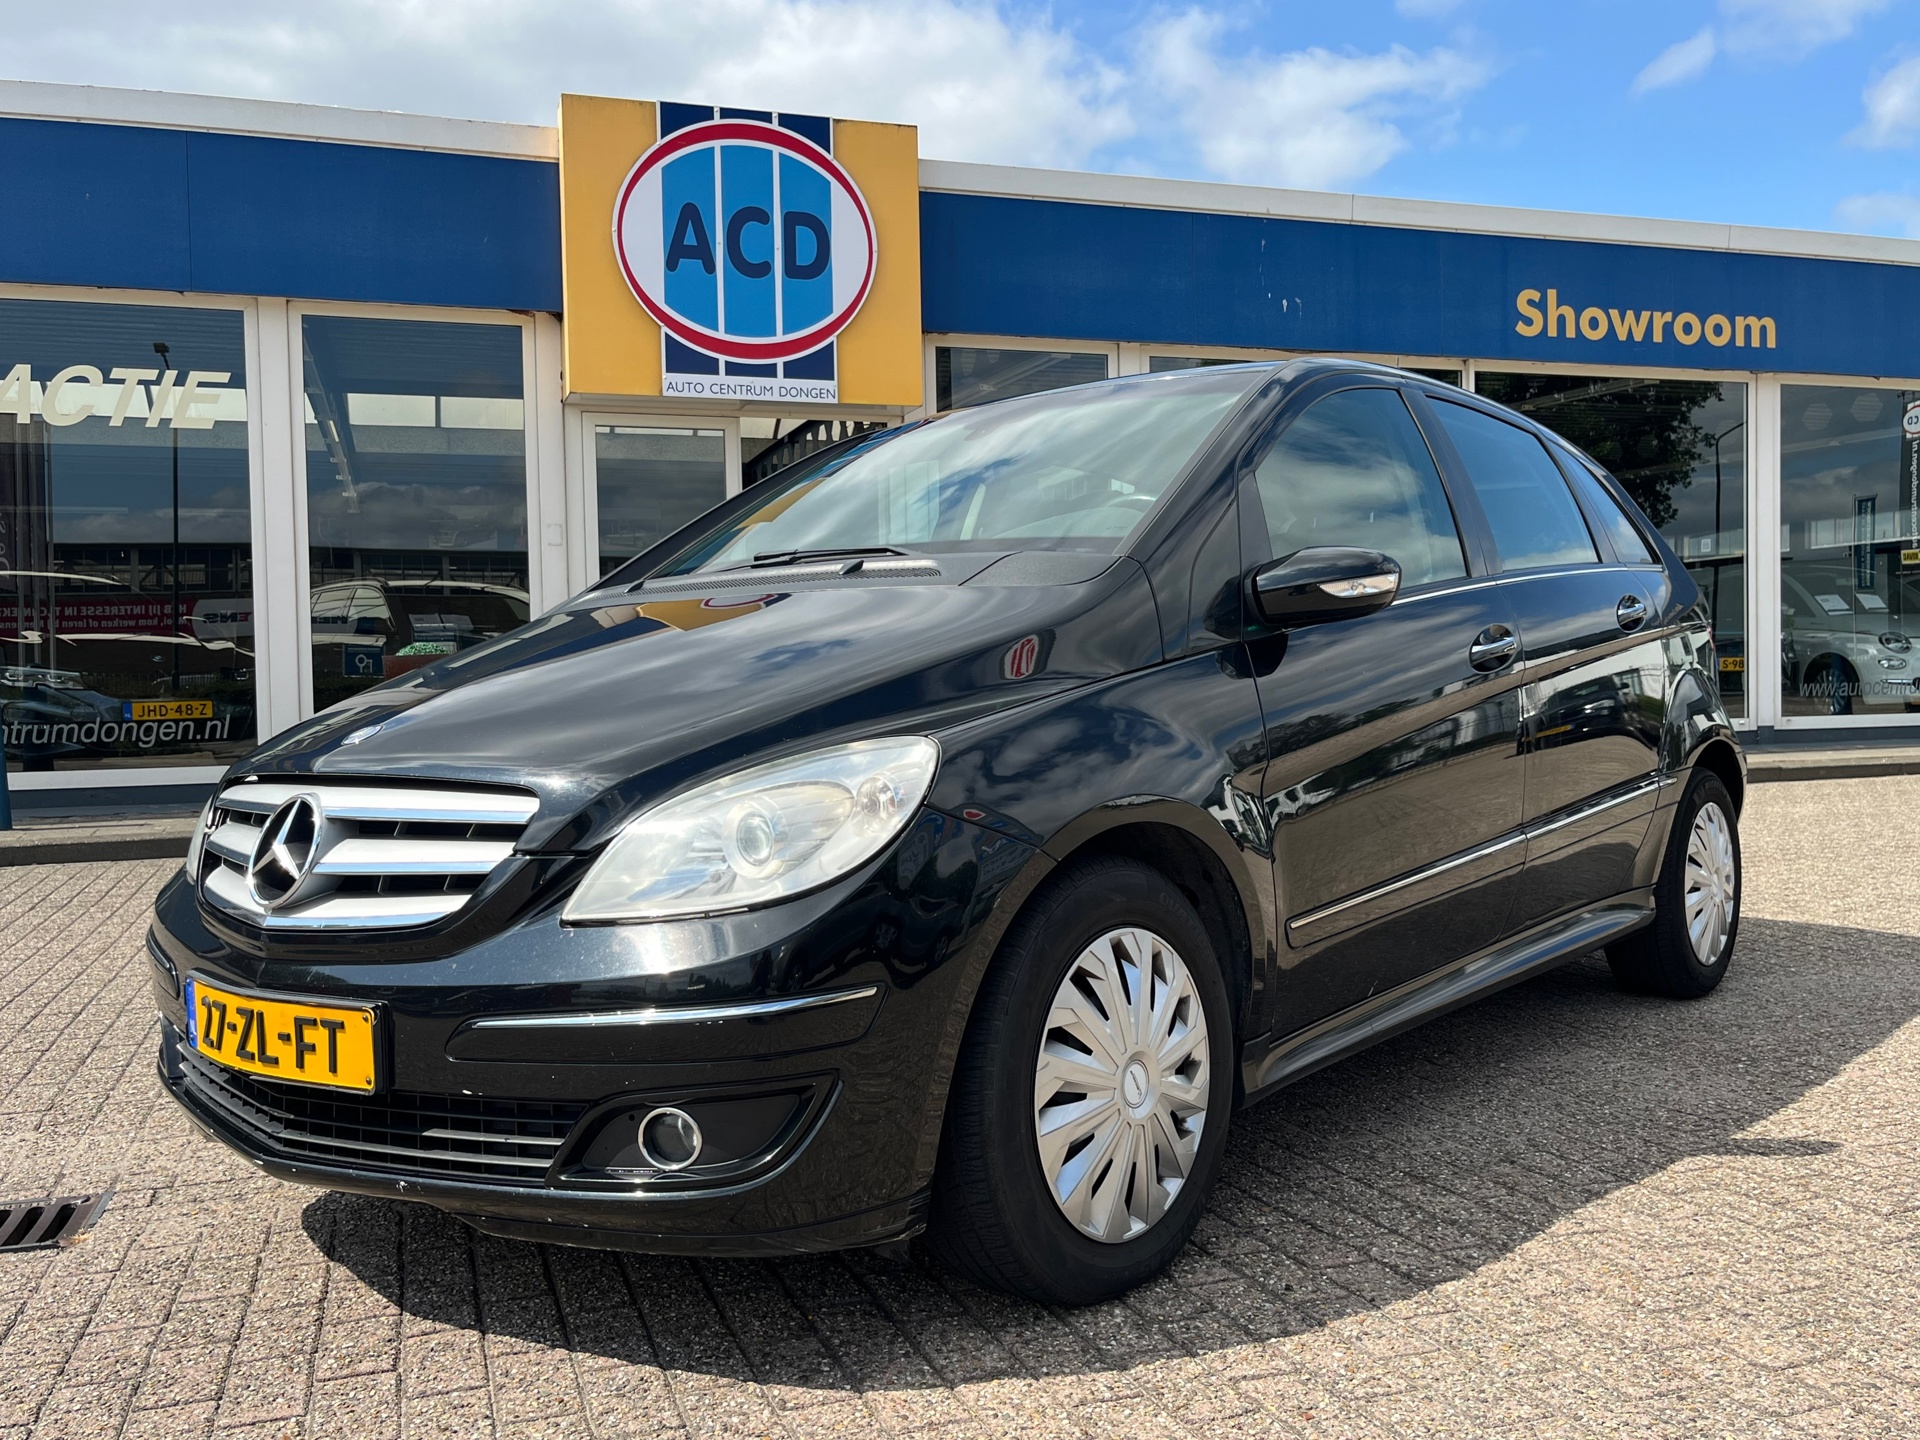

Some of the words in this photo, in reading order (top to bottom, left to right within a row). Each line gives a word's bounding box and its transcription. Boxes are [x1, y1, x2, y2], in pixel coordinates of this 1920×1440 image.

[665, 201, 832, 280] ACD
[1515, 288, 1776, 349] Showroom
[0, 363, 232, 430] ACTIE
[666, 380, 705, 395] AUTO
[709, 382, 774, 398] CENTRUM
[778, 385, 837, 400] DONGEN
[138, 702, 208, 718] JHD-48-Z
[201, 995, 345, 1073] 27-ZL-FT
